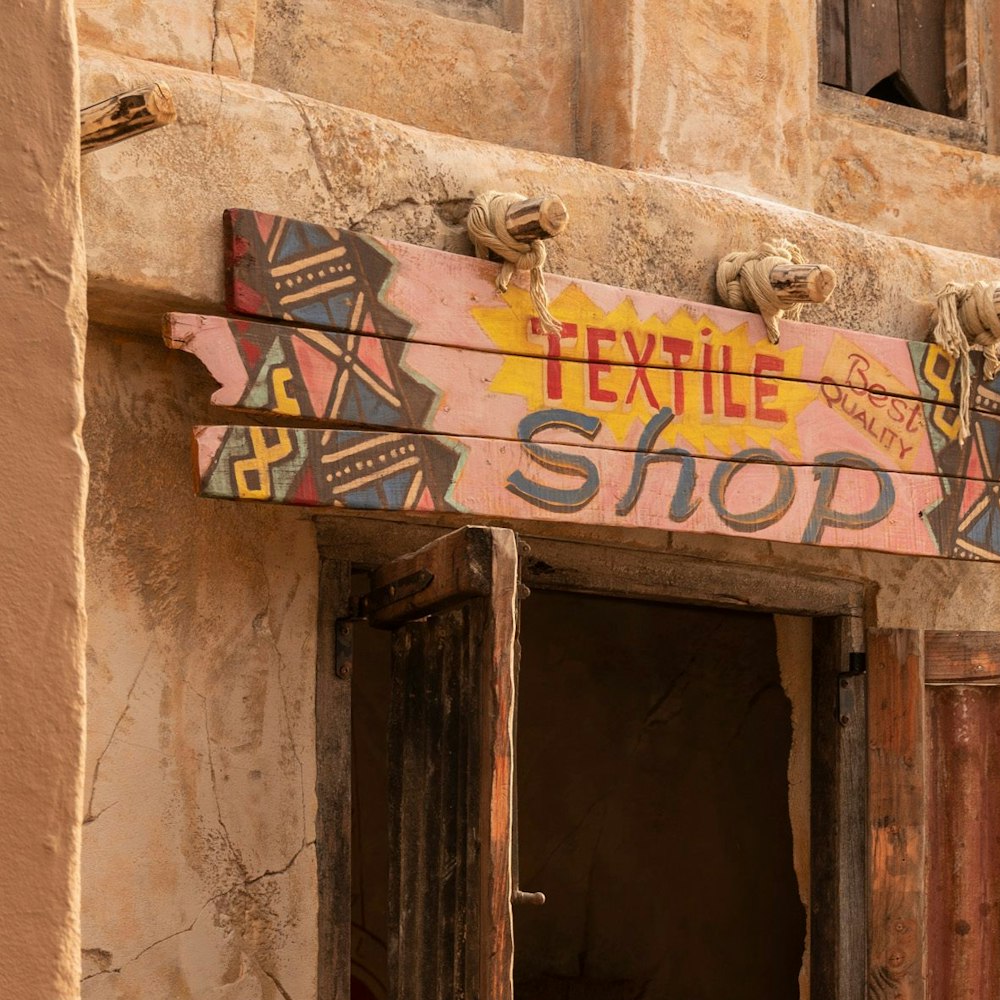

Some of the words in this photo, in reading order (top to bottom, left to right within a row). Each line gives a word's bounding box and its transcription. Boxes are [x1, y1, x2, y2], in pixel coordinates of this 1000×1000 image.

[818, 374, 913, 460] QUALITY
[846, 352, 924, 434] Best
[505, 405, 897, 546] Shop
